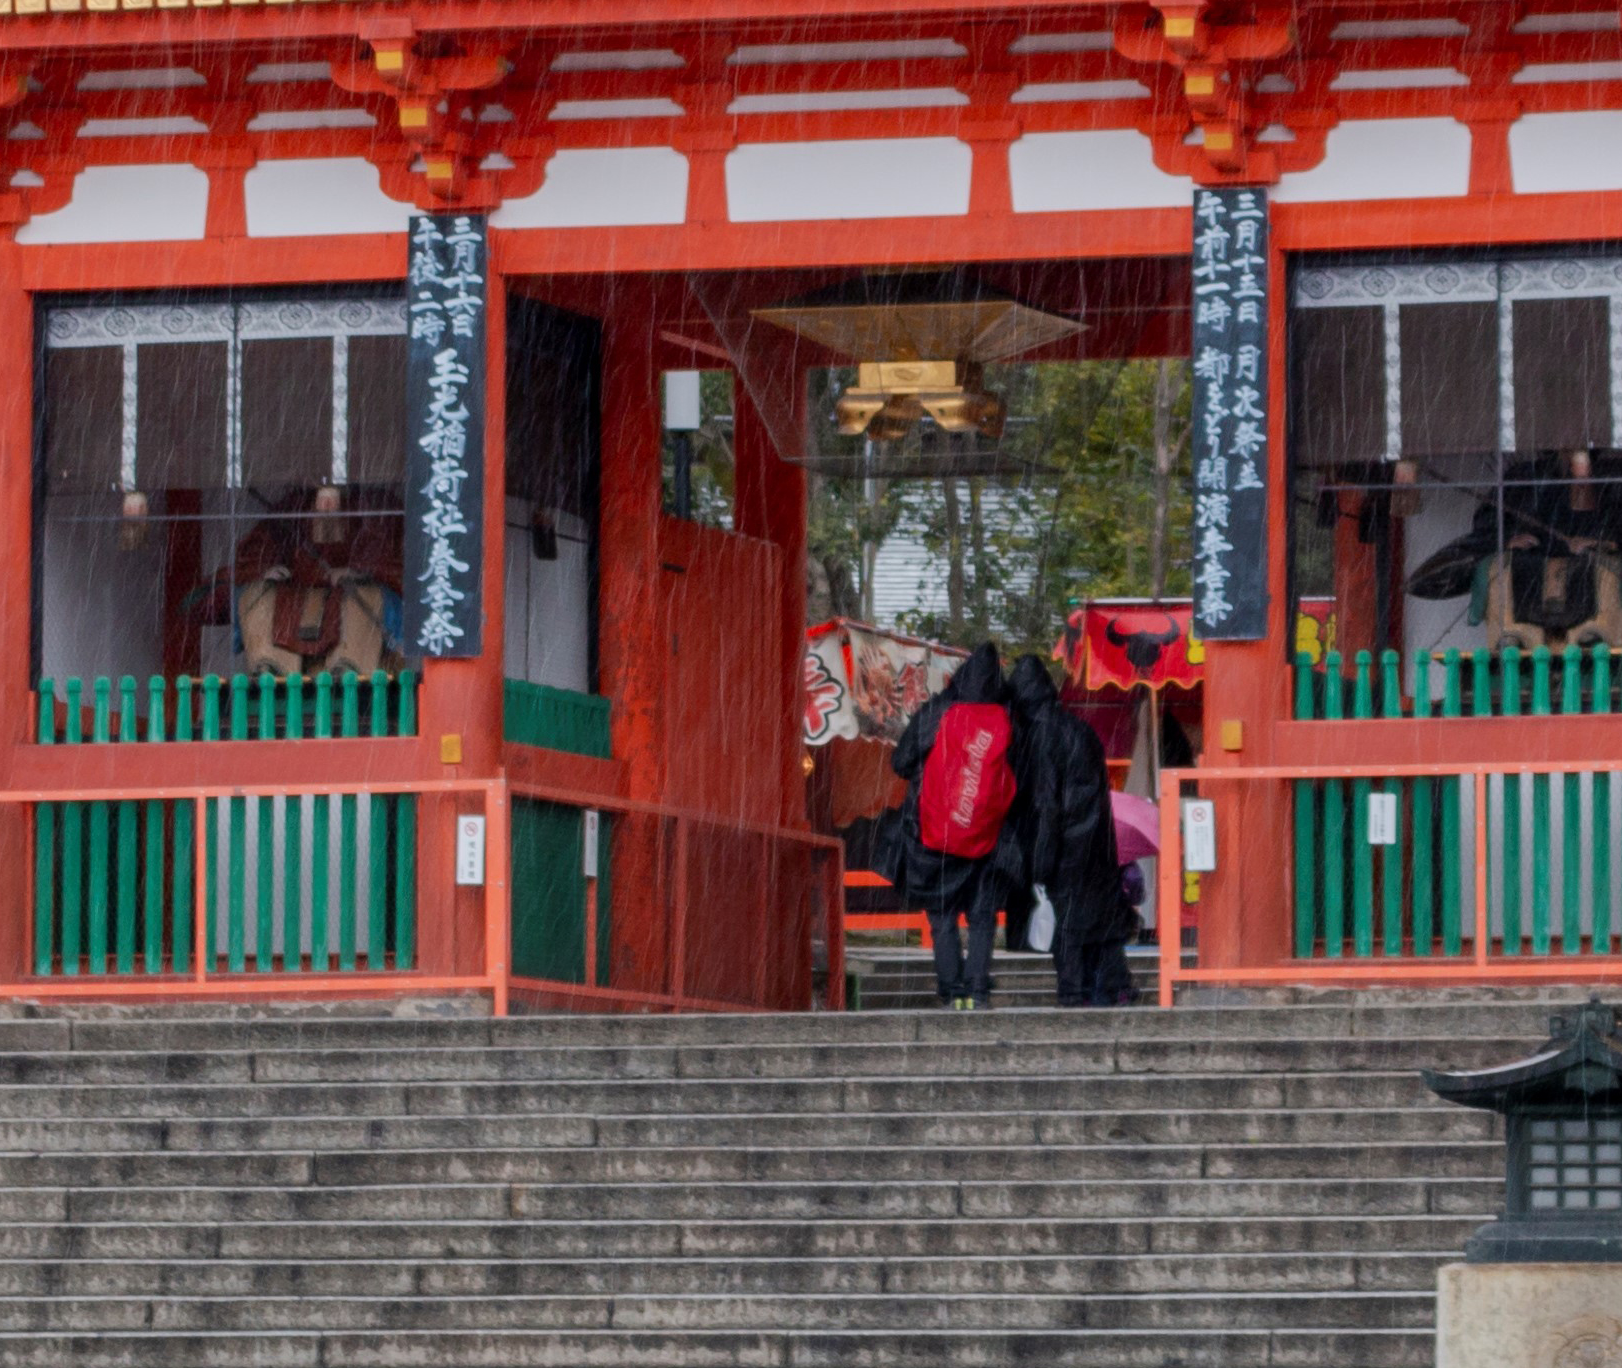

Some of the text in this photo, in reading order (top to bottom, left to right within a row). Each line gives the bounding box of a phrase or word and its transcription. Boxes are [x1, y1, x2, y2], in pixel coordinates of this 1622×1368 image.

[410, 216, 447, 347] 午後二時
[443, 216, 484, 338] 三月十六日
[1193, 190, 1232, 333] 午前十一時
[1229, 192, 1267, 491] 三月十五日 月次祭並
[417, 347, 471, 656] 玉光稲荷社春季祭
[1194, 345, 1234, 628] 都をどり開演奉告祭
